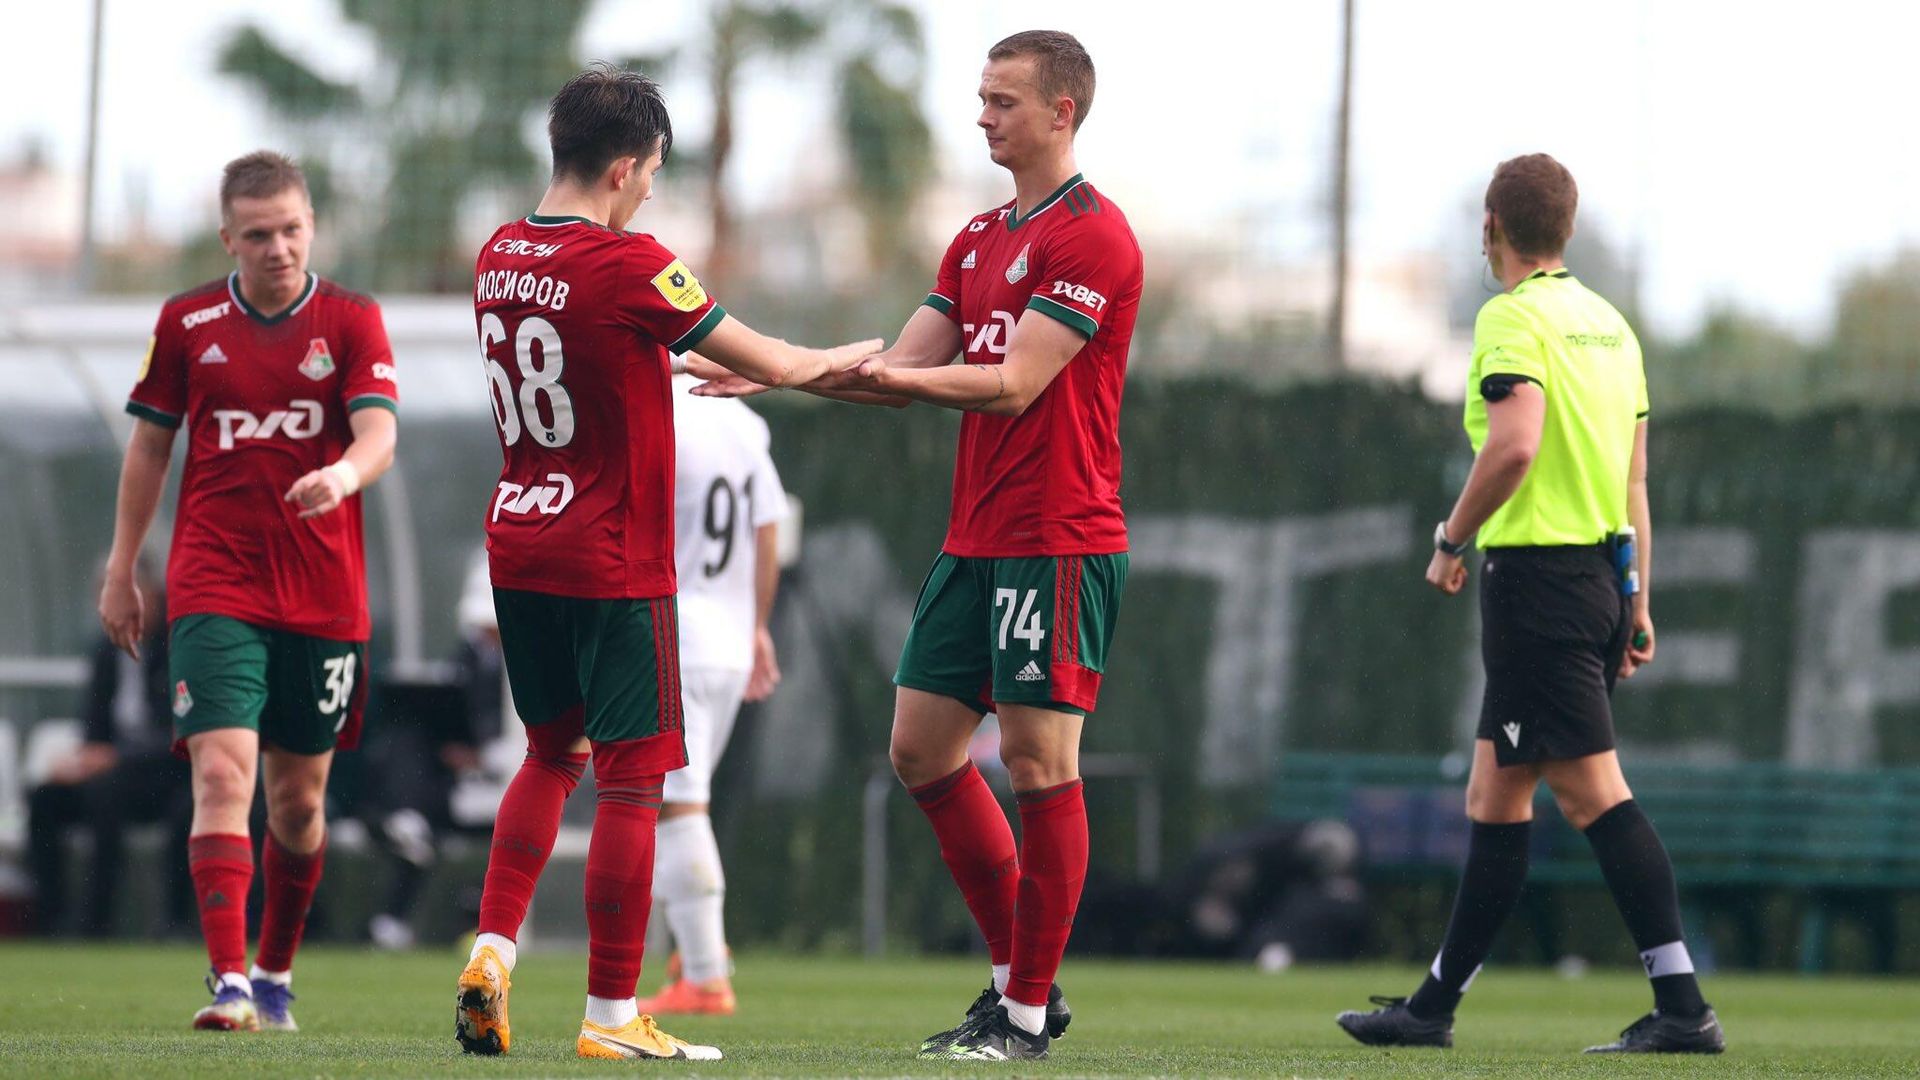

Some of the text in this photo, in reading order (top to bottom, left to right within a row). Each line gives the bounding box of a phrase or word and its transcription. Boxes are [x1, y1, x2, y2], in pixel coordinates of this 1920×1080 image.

[476, 269, 570, 311] ИОСИФОВ
[1052, 280, 1107, 312] 1XBET
[480, 313, 575, 448] 68
[704, 475, 755, 578] 91
[996, 588, 1046, 651] 74
[1015, 672, 1046, 681] adidas
